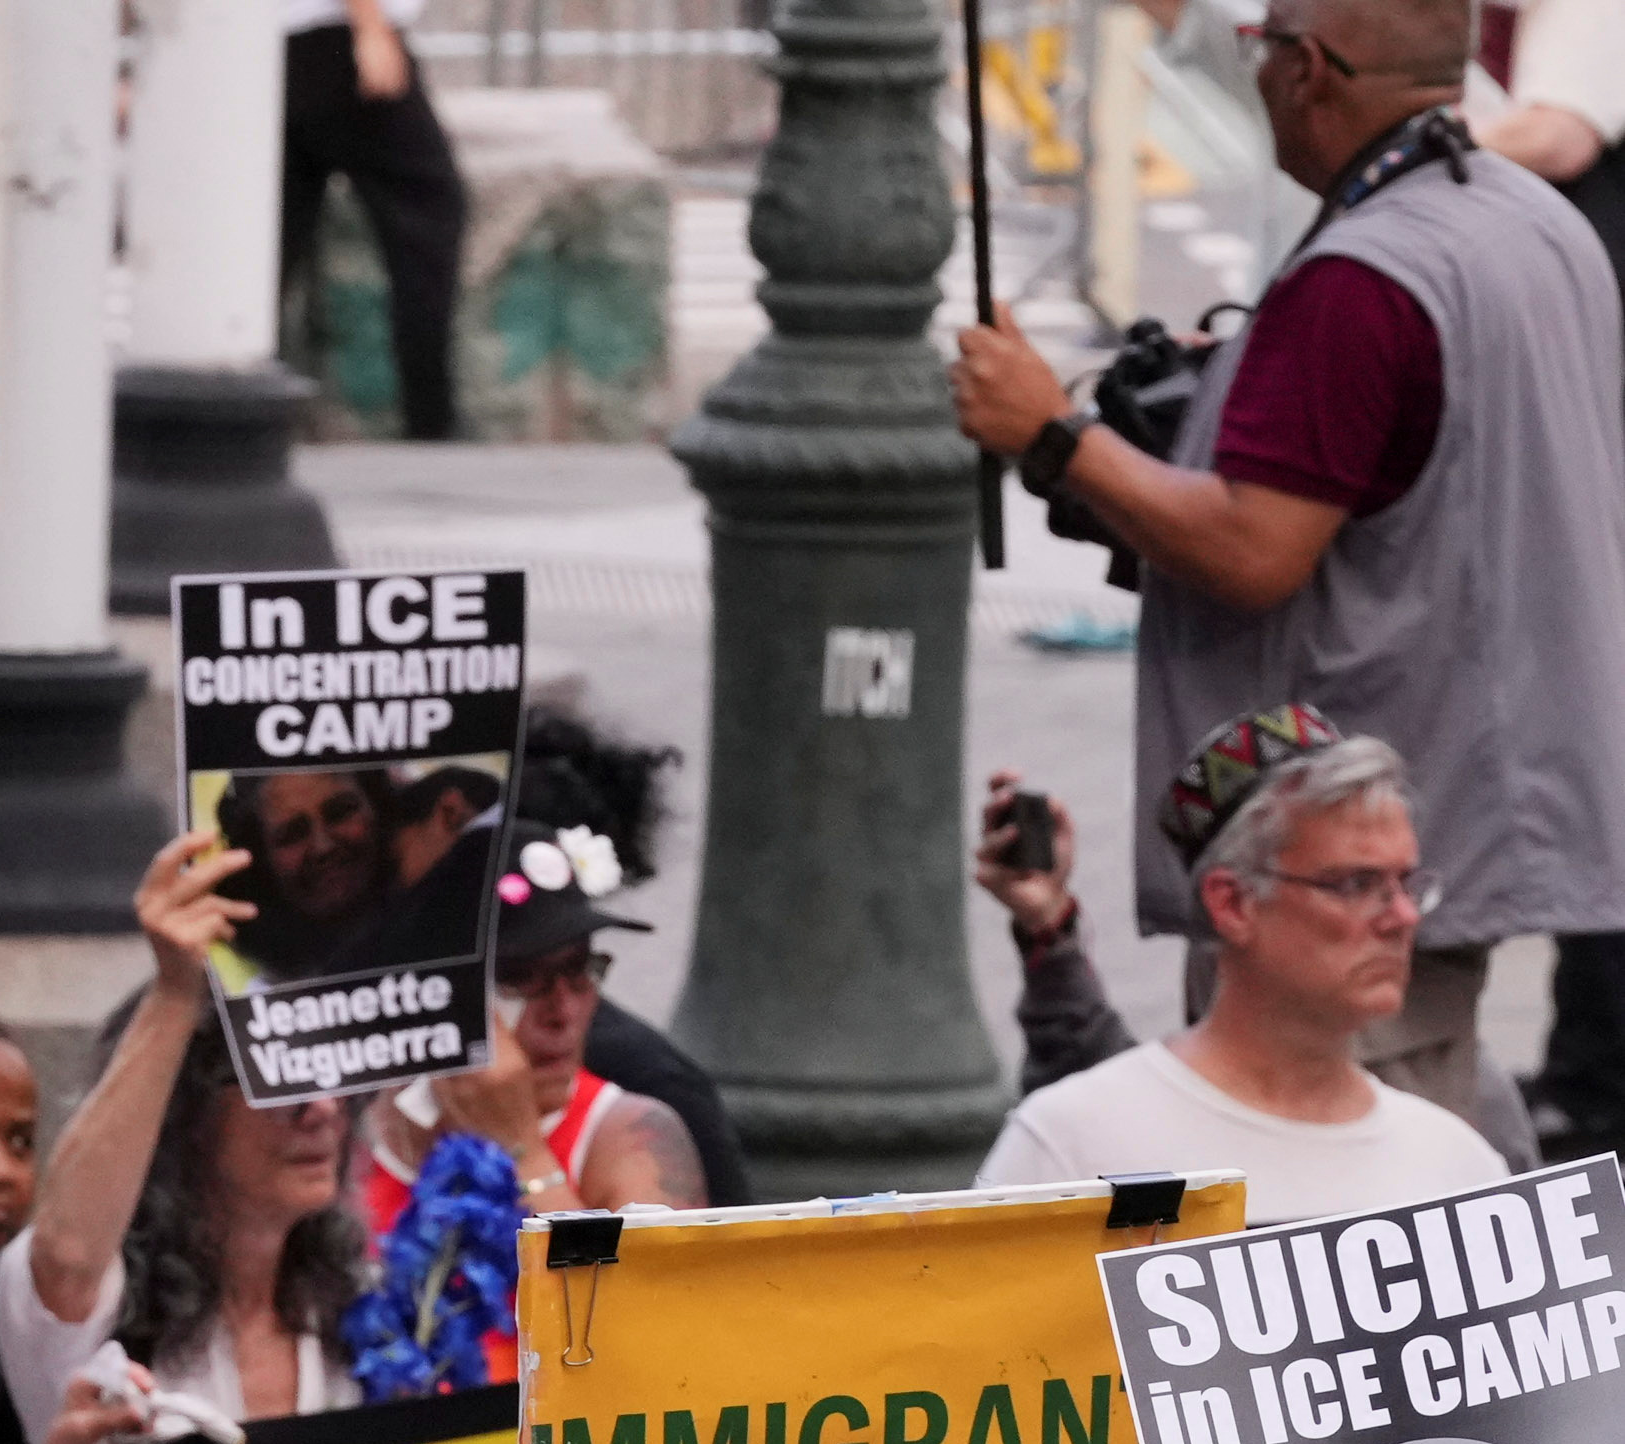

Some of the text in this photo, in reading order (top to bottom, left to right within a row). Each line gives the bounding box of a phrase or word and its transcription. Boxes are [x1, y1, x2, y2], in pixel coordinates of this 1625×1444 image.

[217, 574, 489, 650] In ICE
[181, 643, 521, 707] CONCENTRATION
[255, 697, 454, 758] CAMP
[246, 970, 453, 1042] Jeanette
[247, 1021, 463, 1090] Vizguerra
[1133, 1173, 1616, 1368] SUICIDE
